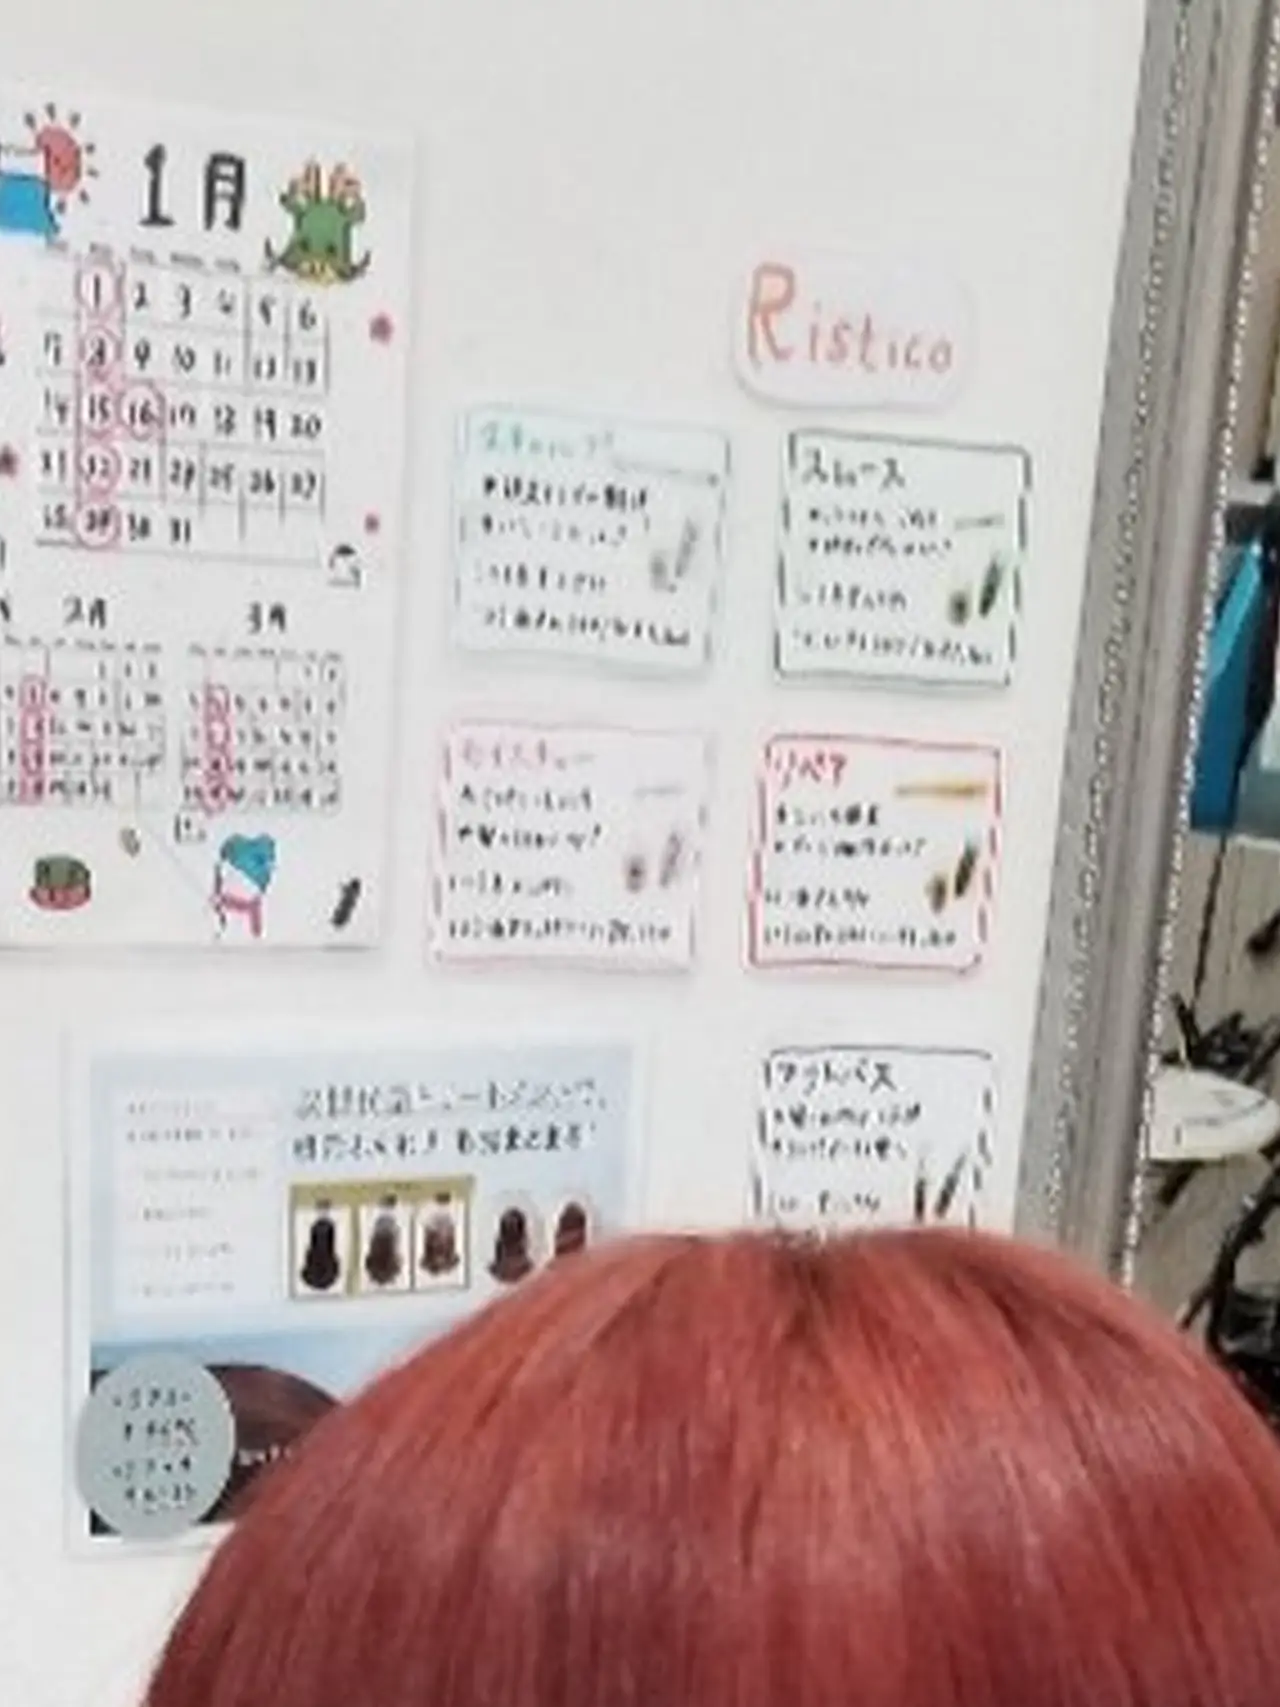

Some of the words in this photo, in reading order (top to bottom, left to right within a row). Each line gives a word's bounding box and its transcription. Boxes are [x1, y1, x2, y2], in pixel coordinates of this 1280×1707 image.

[299, 298, 317, 330] 6
[747, 261, 953, 374] Ristico
[134, 339, 150, 370] 9
[88, 395, 110, 421] 15
[129, 399, 153, 425] 16
